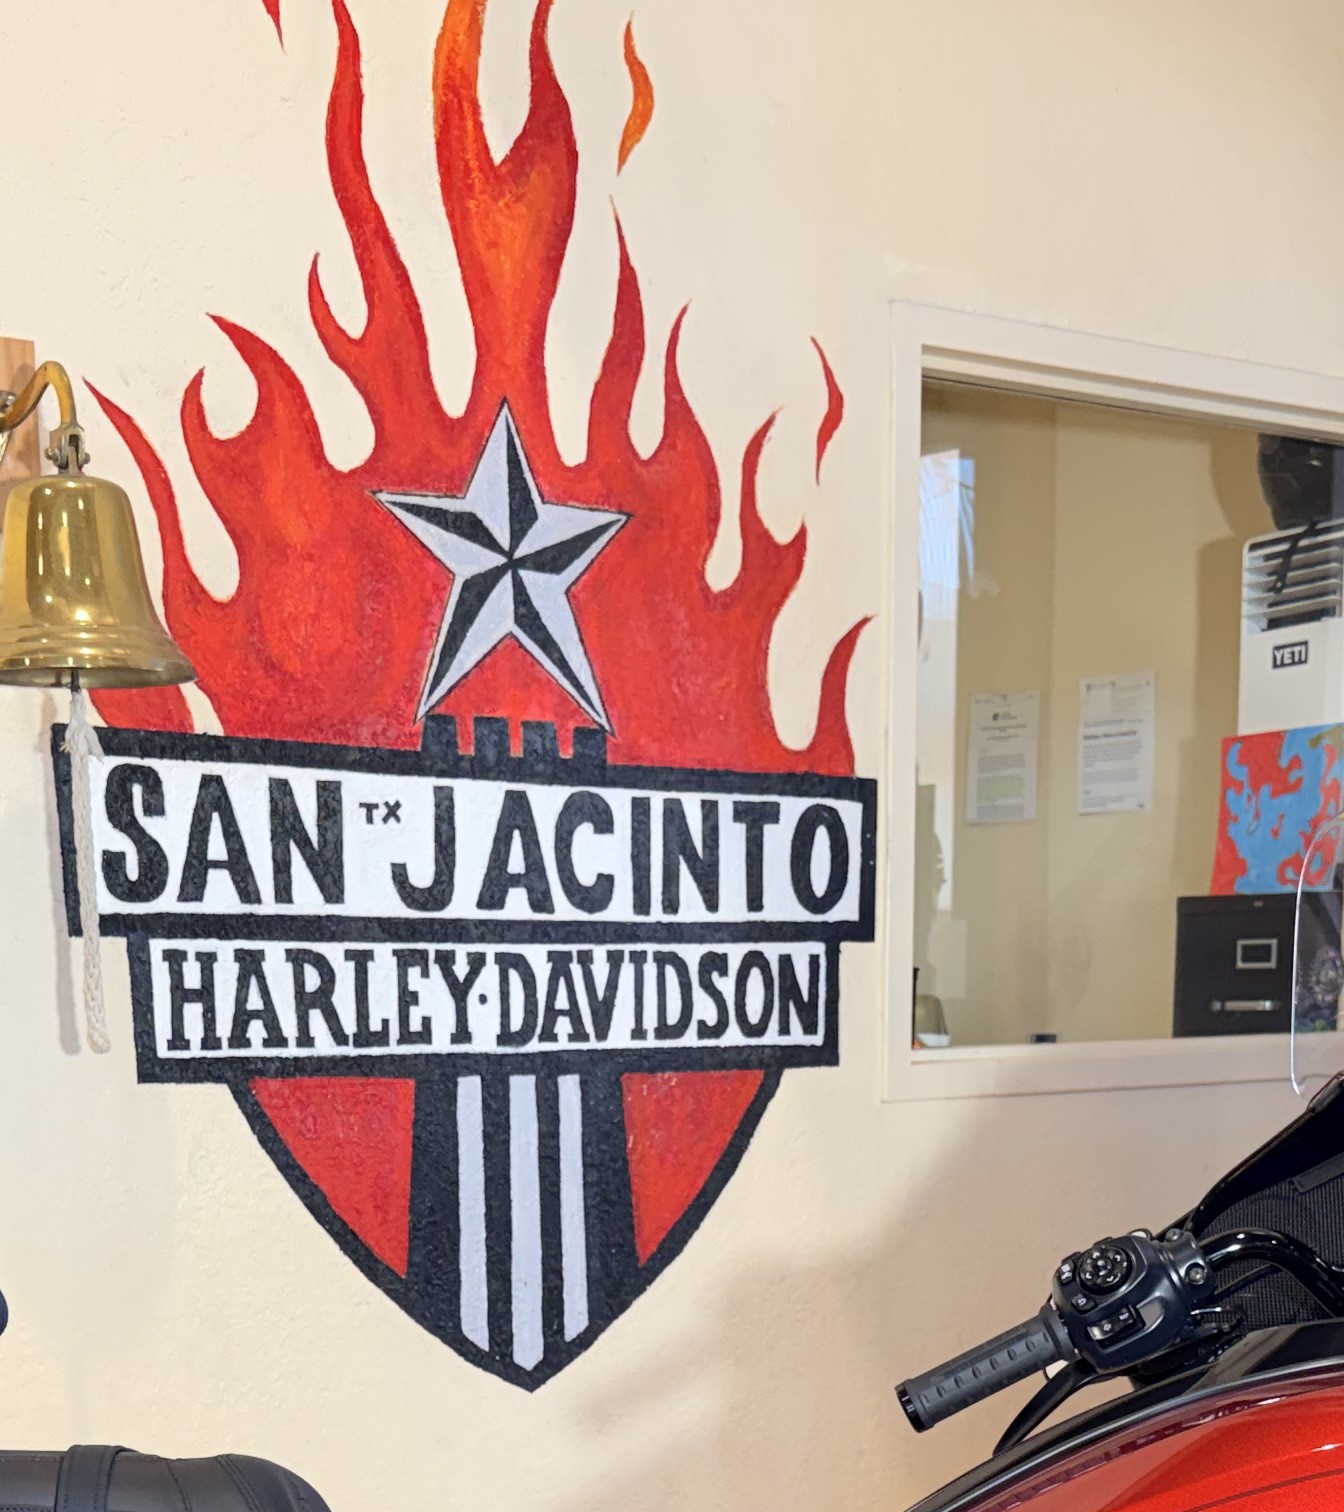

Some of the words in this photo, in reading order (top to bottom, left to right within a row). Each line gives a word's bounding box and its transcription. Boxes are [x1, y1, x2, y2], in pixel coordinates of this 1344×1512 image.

[1273, 644, 1306, 666] YETI
[101, 762, 346, 906] SAN
[358, 800, 402, 826] TX
[390, 785, 850, 915] JACINTO
